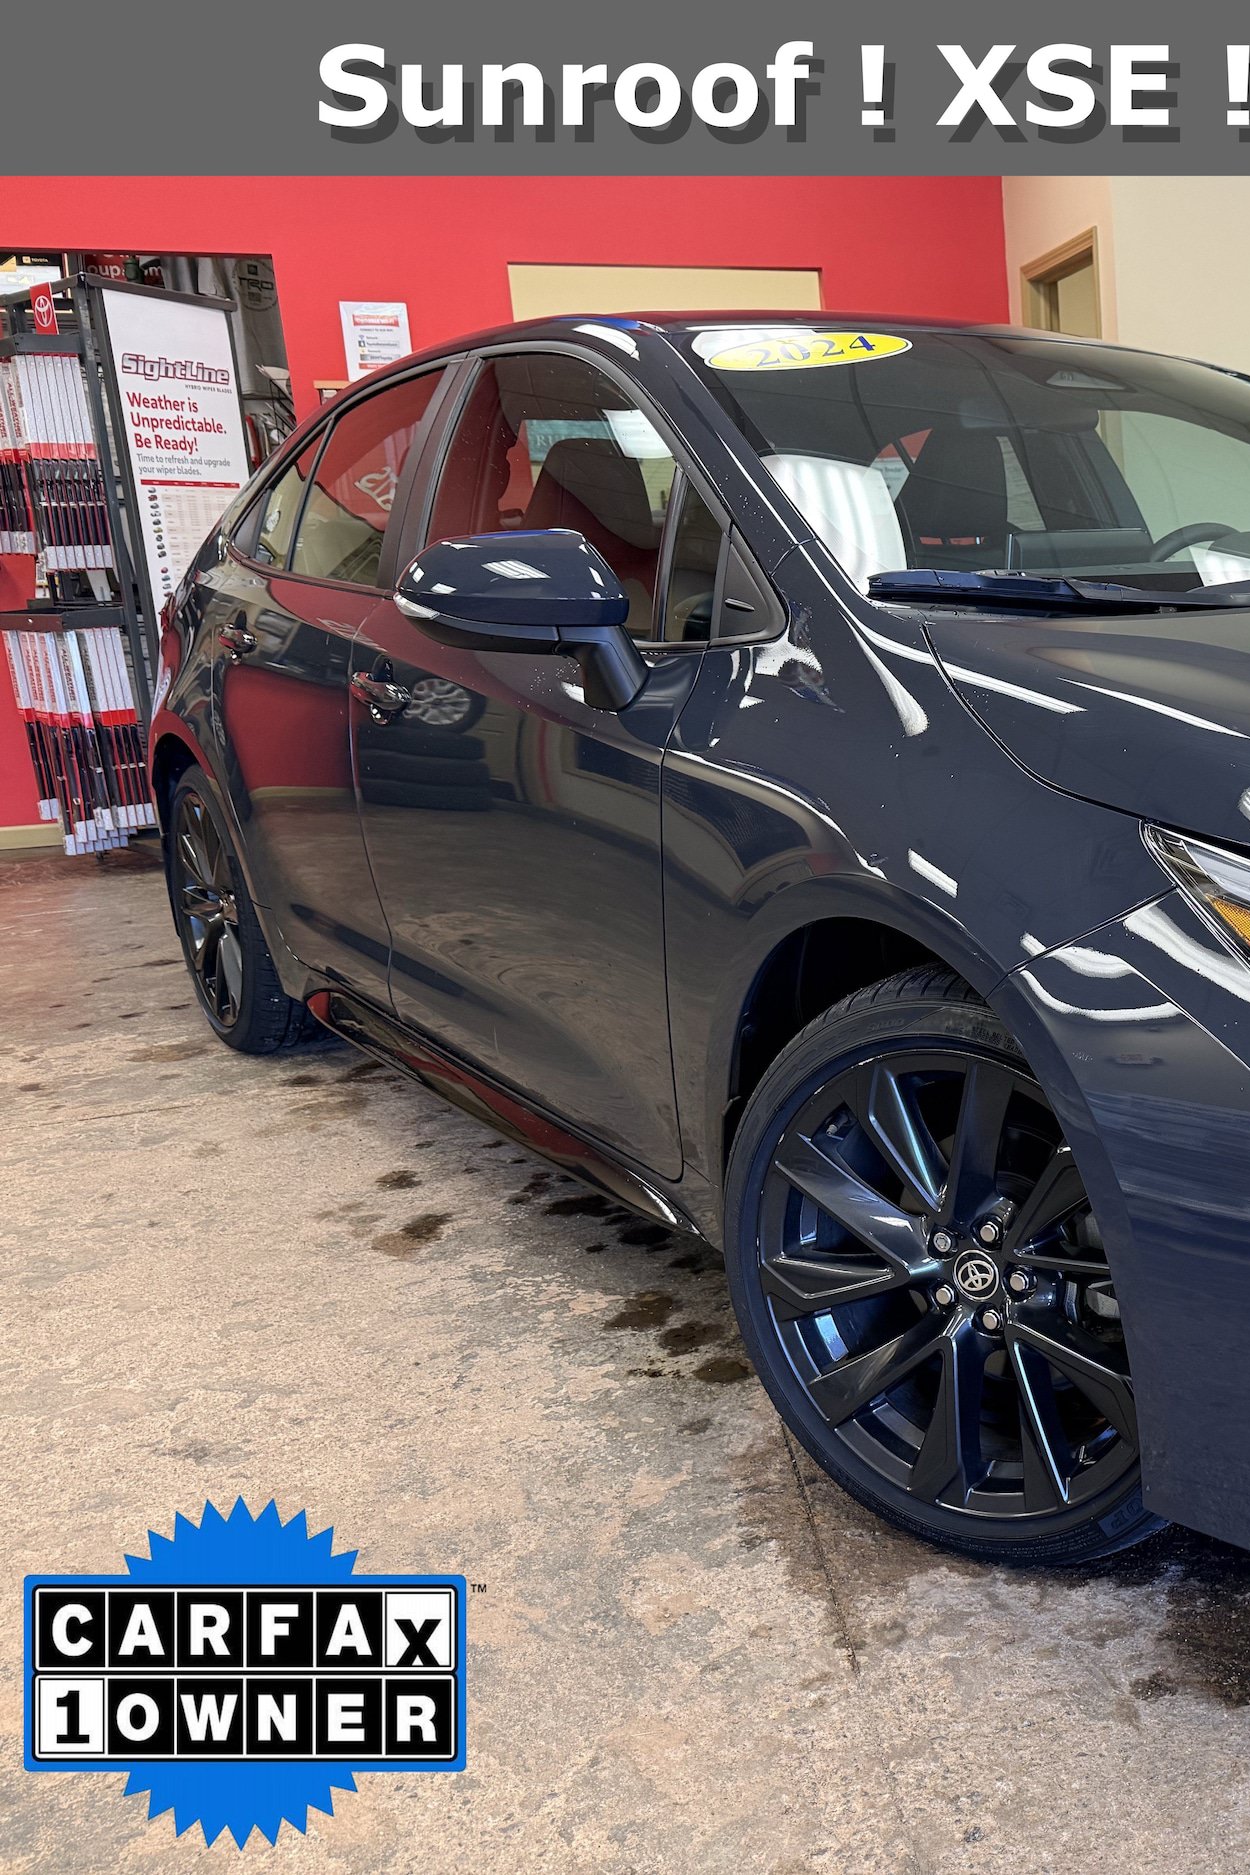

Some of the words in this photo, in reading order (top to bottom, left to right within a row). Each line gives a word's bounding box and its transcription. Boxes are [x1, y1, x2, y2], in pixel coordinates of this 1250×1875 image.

[750, 335, 876, 368] 2024
[121, 352, 230, 386] SightLine
[126, 391, 186, 411] Weather
[187, 397, 199, 413] is
[130, 411, 227, 434] Unpredictable.
[134, 433, 152, 449] Be
[154, 434, 199, 455] Ready!
[136, 453, 155, 463] Time
[156, 455, 164, 463] to
[165, 454, 189, 465] refresh
[190, 456, 203, 465] and
[204, 457, 231, 468] upgrade
[138, 466, 155, 475] your
[156, 465, 176, 475] wiper
[176, 465, 202, 476] blades.
